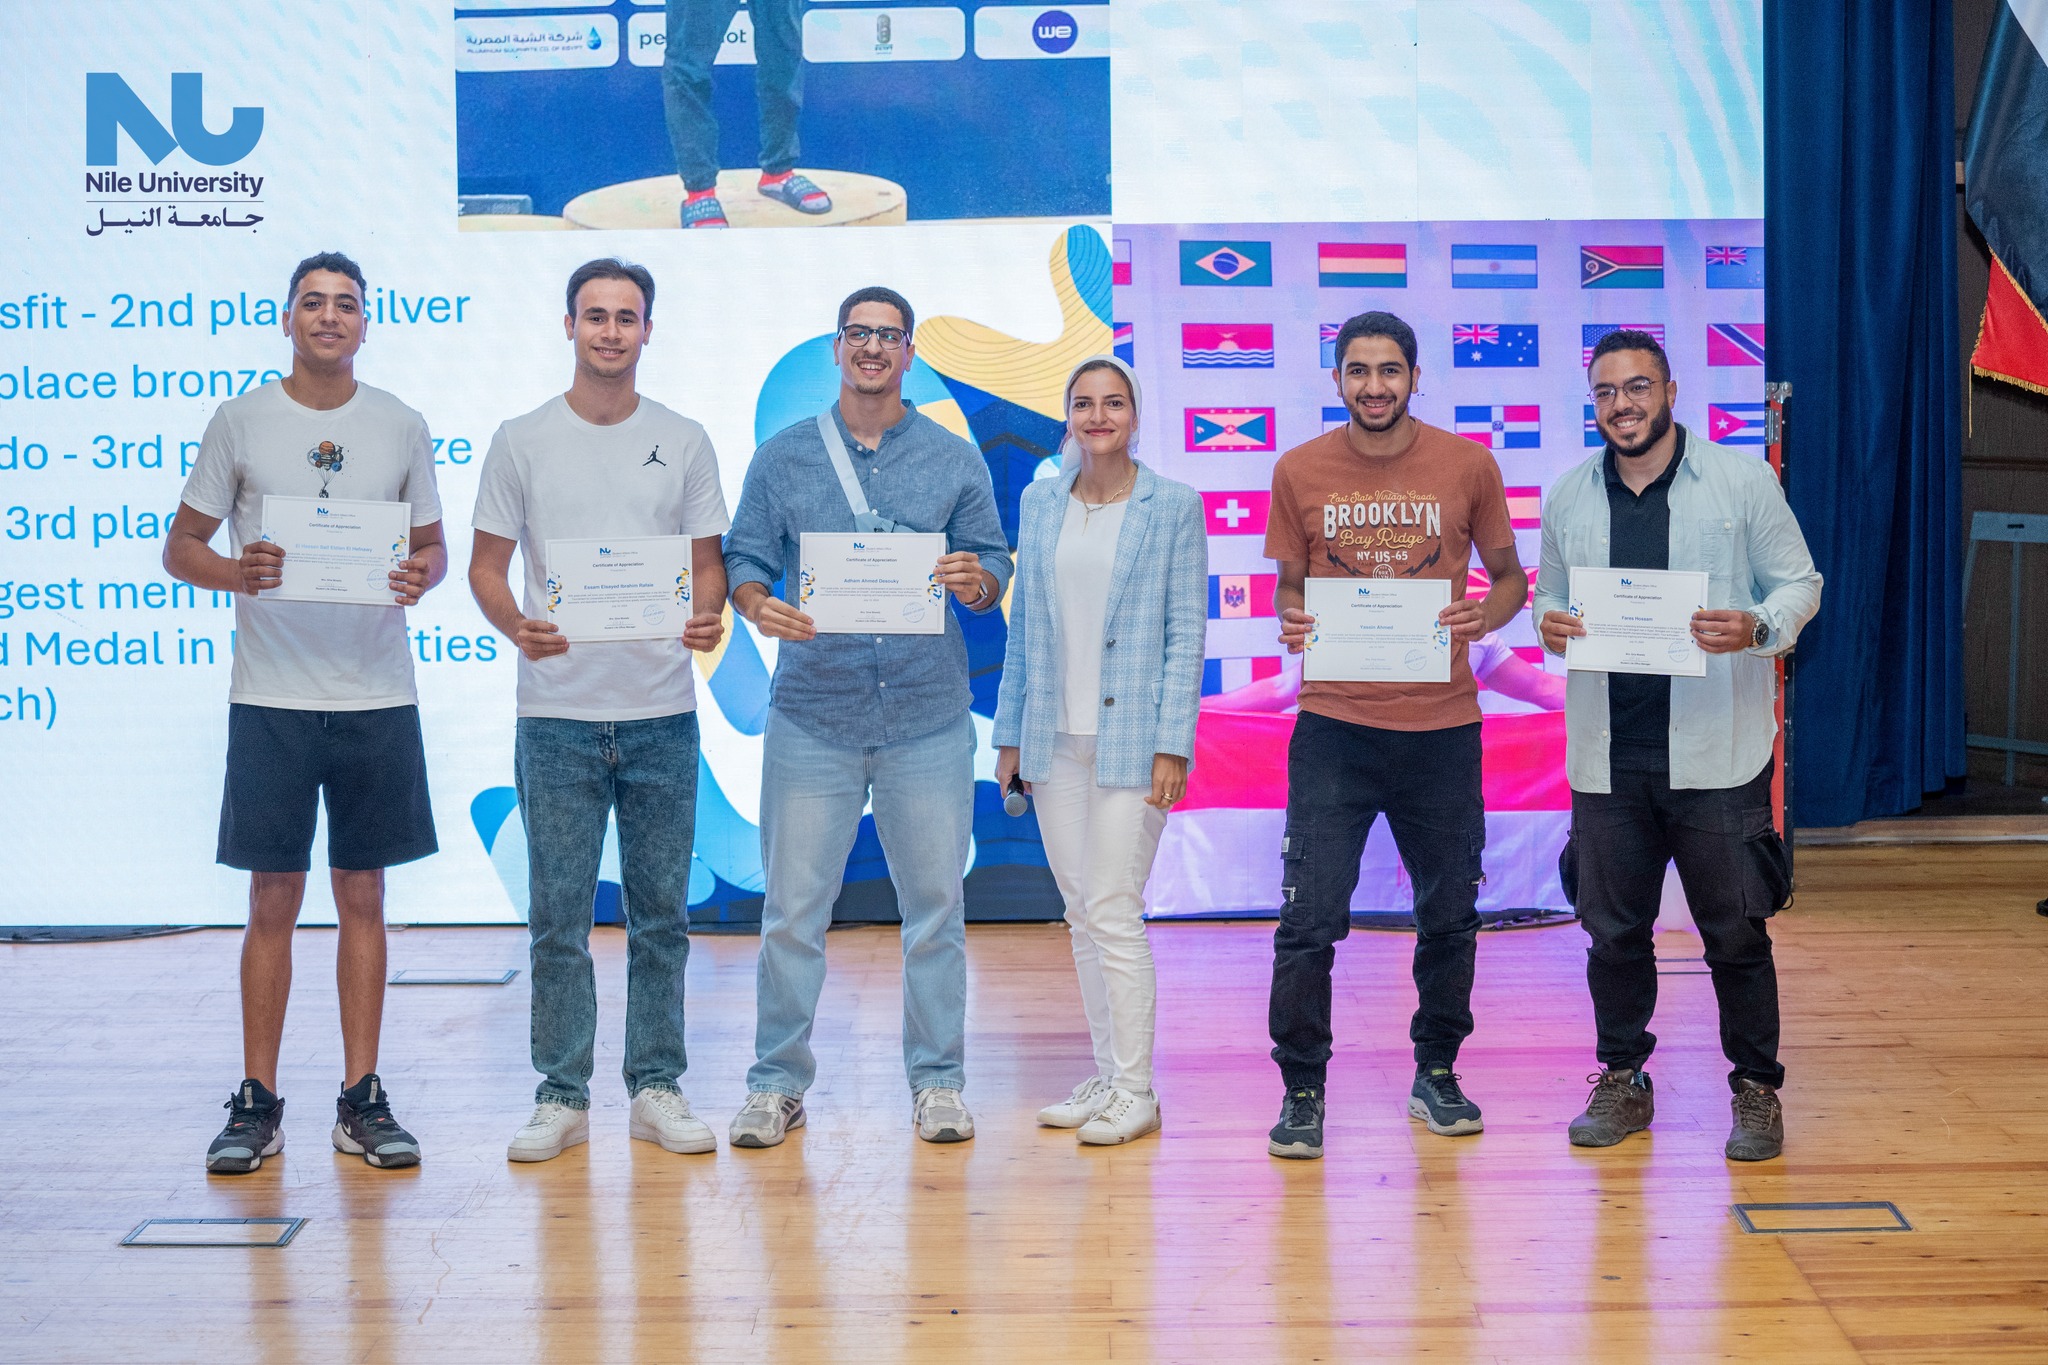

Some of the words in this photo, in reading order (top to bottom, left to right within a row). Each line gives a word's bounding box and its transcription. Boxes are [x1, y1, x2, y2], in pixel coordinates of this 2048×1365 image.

[110, 293, 194, 329] 2nd
[92, 434, 162, 470] 3rd
[6, 505, 76, 540] 3rd
[1324, 502, 1441, 540] BROOKLYN
[1338, 529, 1375, 549] Bay
[1376, 528, 1426, 550] Ridge
[1356, 551, 1408, 563] NY-US-65
[98, 582, 194, 610] men
[26, 631, 164, 666] Medal
[178, 628, 214, 664] in
